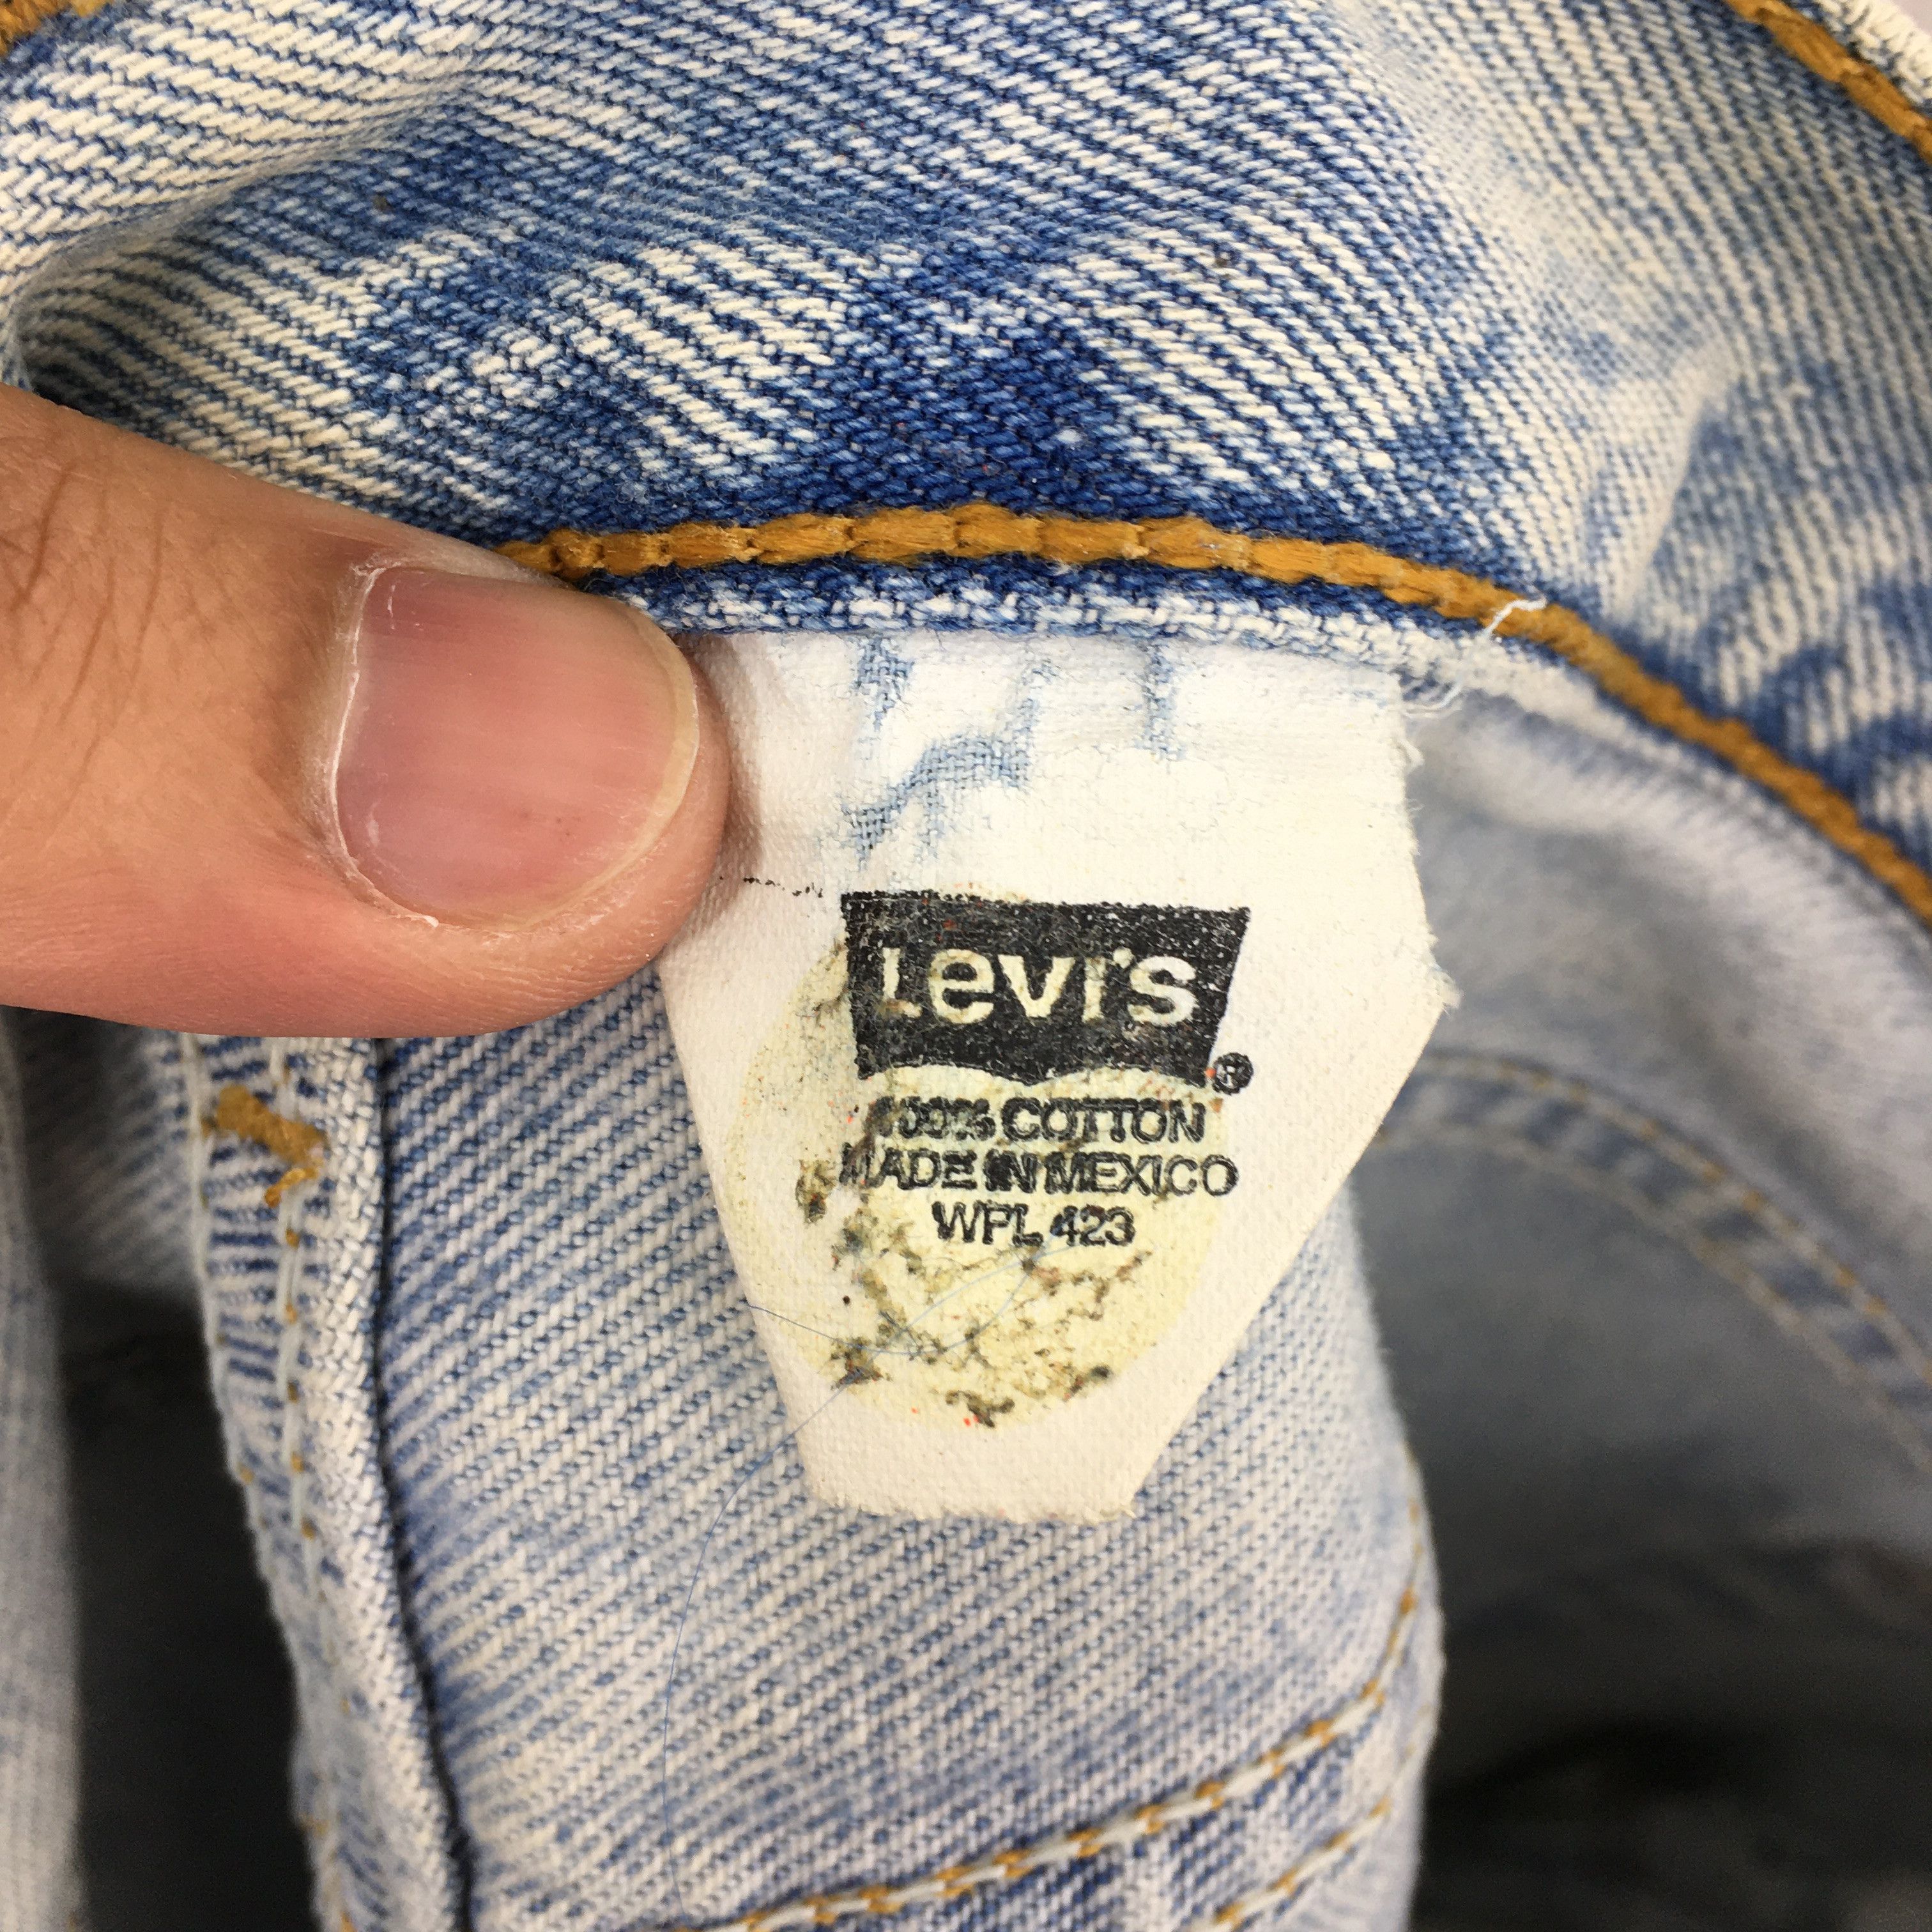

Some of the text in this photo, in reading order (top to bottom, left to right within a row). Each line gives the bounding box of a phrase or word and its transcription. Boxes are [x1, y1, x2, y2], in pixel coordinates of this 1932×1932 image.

[880, 947, 1199, 1025] Levi's
[1000, 1096, 1206, 1143] COTTON
[838, 1142, 1239, 1197] MADE IN MEXICO
[931, 1200, 1136, 1246] WPL 423
